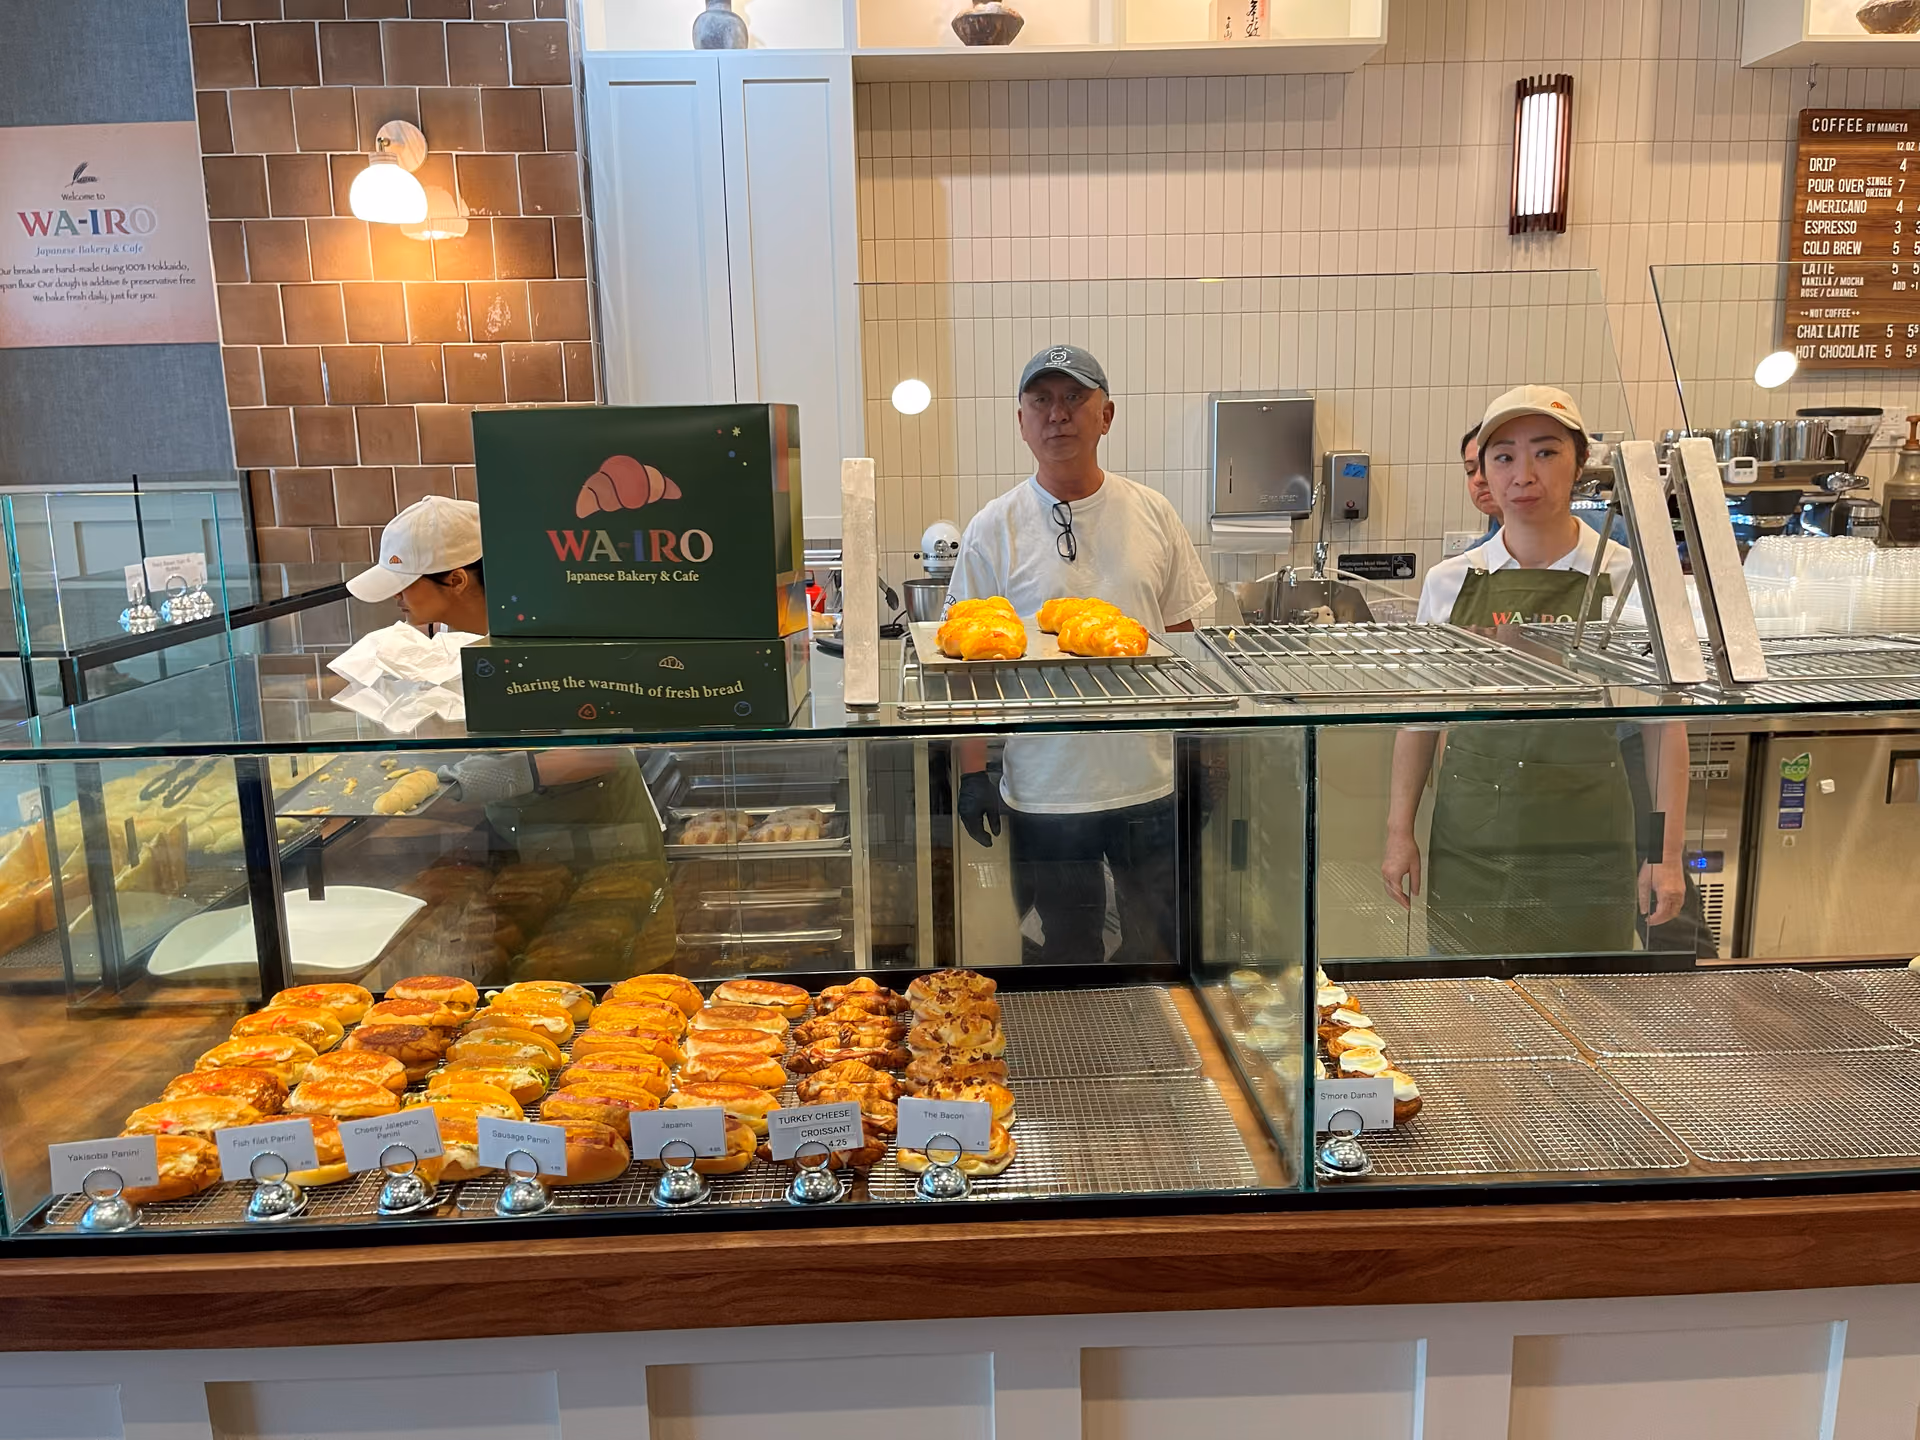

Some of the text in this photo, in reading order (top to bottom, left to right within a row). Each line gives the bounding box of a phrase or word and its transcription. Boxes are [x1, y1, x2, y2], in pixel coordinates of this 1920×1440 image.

[1811, 118, 1908, 132] COFFEE BY MAMEYA
[1896, 142, 1904, 151] 12
[1809, 158, 1907, 172] DRIP 4
[1807, 179, 1906, 193] POUR OVER 7
[1866, 177, 1893, 186] SINGLE
[61, 191, 106, 200] Welcome to
[1865, 188, 1892, 198] ORIGIN
[1806, 200, 1868, 214] AMERICANO
[1896, 200, 1903, 214] 4
[17, 207, 157, 237] WA-IRO
[1804, 220, 1858, 235] ESPRESSO
[1894, 220, 1902, 235] 3
[1803, 241, 1830, 255] COLD
[1833, 241, 1862, 255] BREW
[1892, 241, 1900, 255] 5
[1801, 277, 1832, 286] VANILLA
[1839, 277, 1864, 286] MOCHA
[1892, 281, 1907, 291] ADD
[1800, 288, 1819, 298] ROSE
[1826, 288, 1858, 298] CARAMEL
[1809, 309, 1851, 318] NOT COFFEE
[1796, 324, 1824, 339] CHAI
[1827, 324, 1860, 339] LATTE
[1886, 324, 1894, 338] 5
[1795, 345, 1816, 359] HOT
[1819, 344, 1877, 359] CHOCOLATE
[1884, 344, 1892, 358] 5
[545, 529, 713, 563] WA-IRO
[566, 569, 700, 585] Japanese Bakery & Cafe
[506, 676, 744, 699] sharing the warmth of fresh bread
[1784, 766, 1806, 775] ECO
[1320, 1091, 1378, 1100] S'more Danish
[778, 1109, 850, 1125] TURKEY CHEESE
[923, 1111, 965, 1120] The Bacon
[801, 1124, 852, 1138] CROISSANT
[828, 1138, 847, 1148] 4.25
[67, 1148, 140, 1162] Yakisoba Panini
